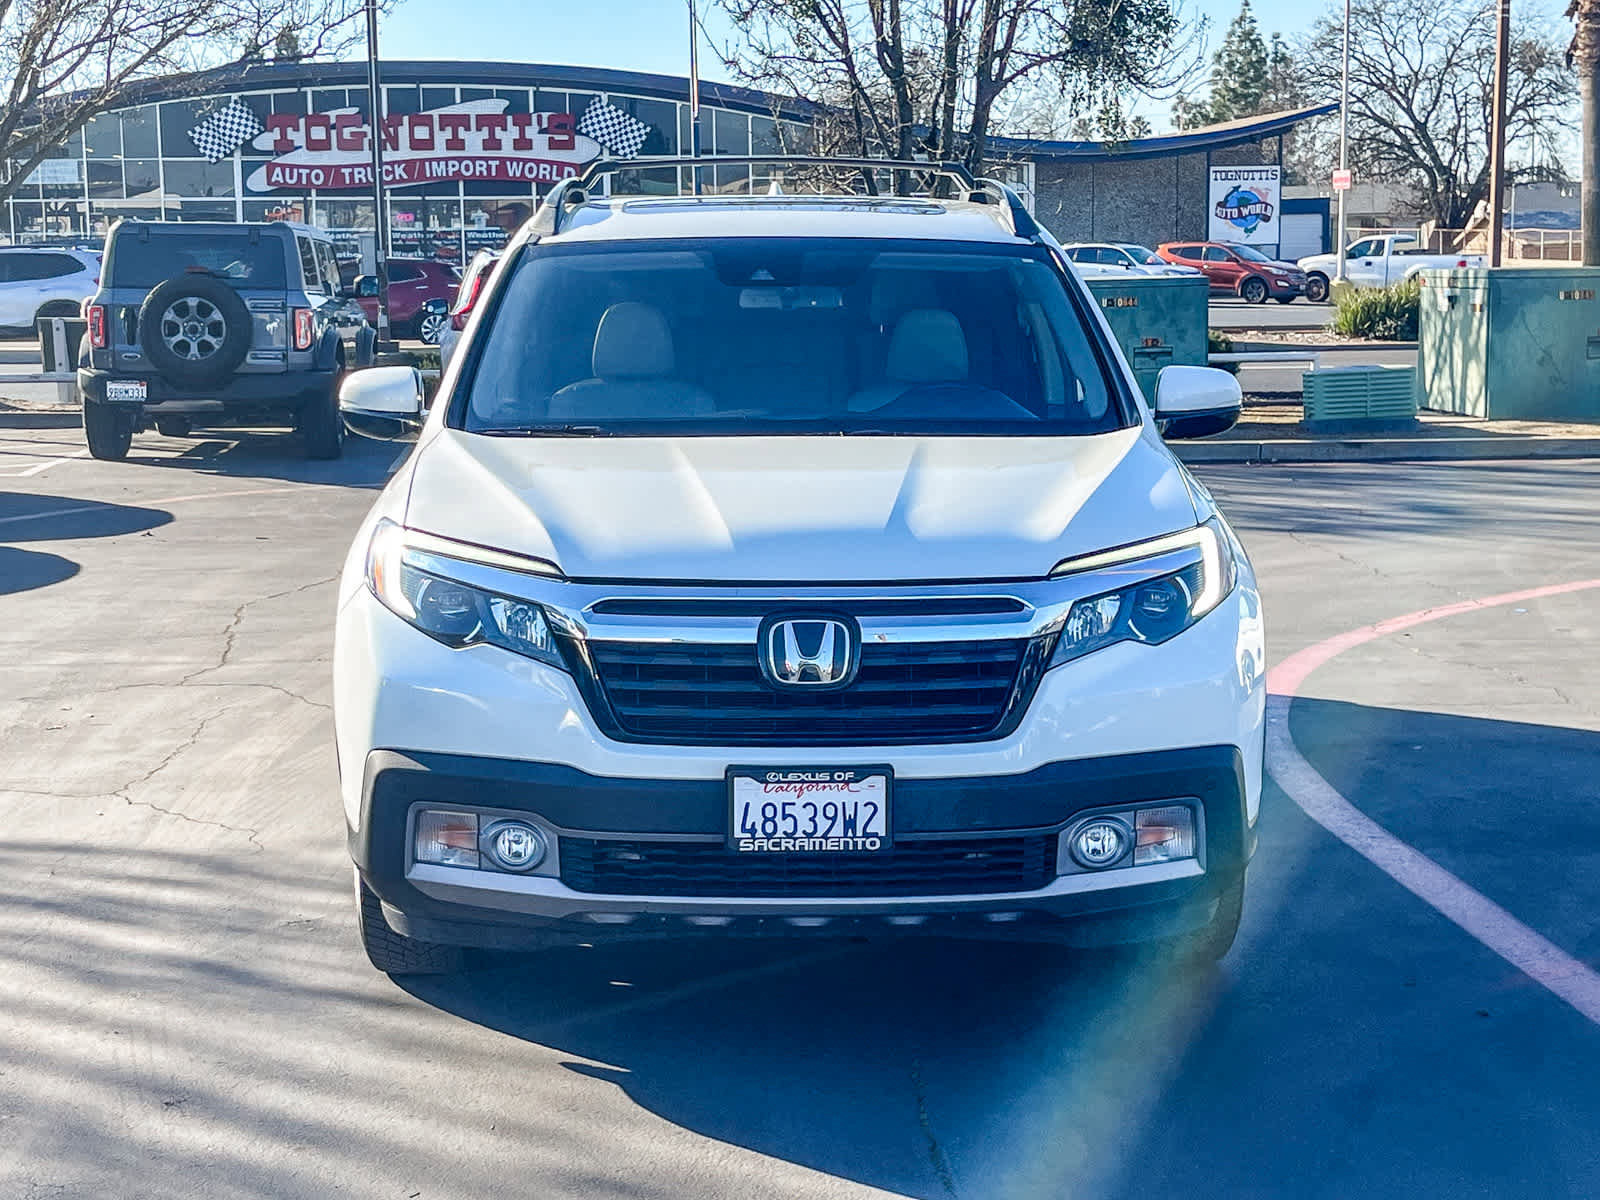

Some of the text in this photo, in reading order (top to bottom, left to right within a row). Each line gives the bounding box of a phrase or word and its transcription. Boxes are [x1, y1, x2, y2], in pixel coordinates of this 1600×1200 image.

[267, 113, 576, 151] TOGNOTTI'S
[271, 166, 325, 186] AUTO
[341, 163, 409, 185] TRUCK
[425, 159, 500, 178] IMPORT
[506, 160, 577, 182] WORLD
[1215, 202, 1273, 218] AUTO WORLD
[779, 771, 855, 781] LEXUS OF
[740, 801, 880, 838] 48539W2
[739, 837, 881, 851] SACRAMENTO
